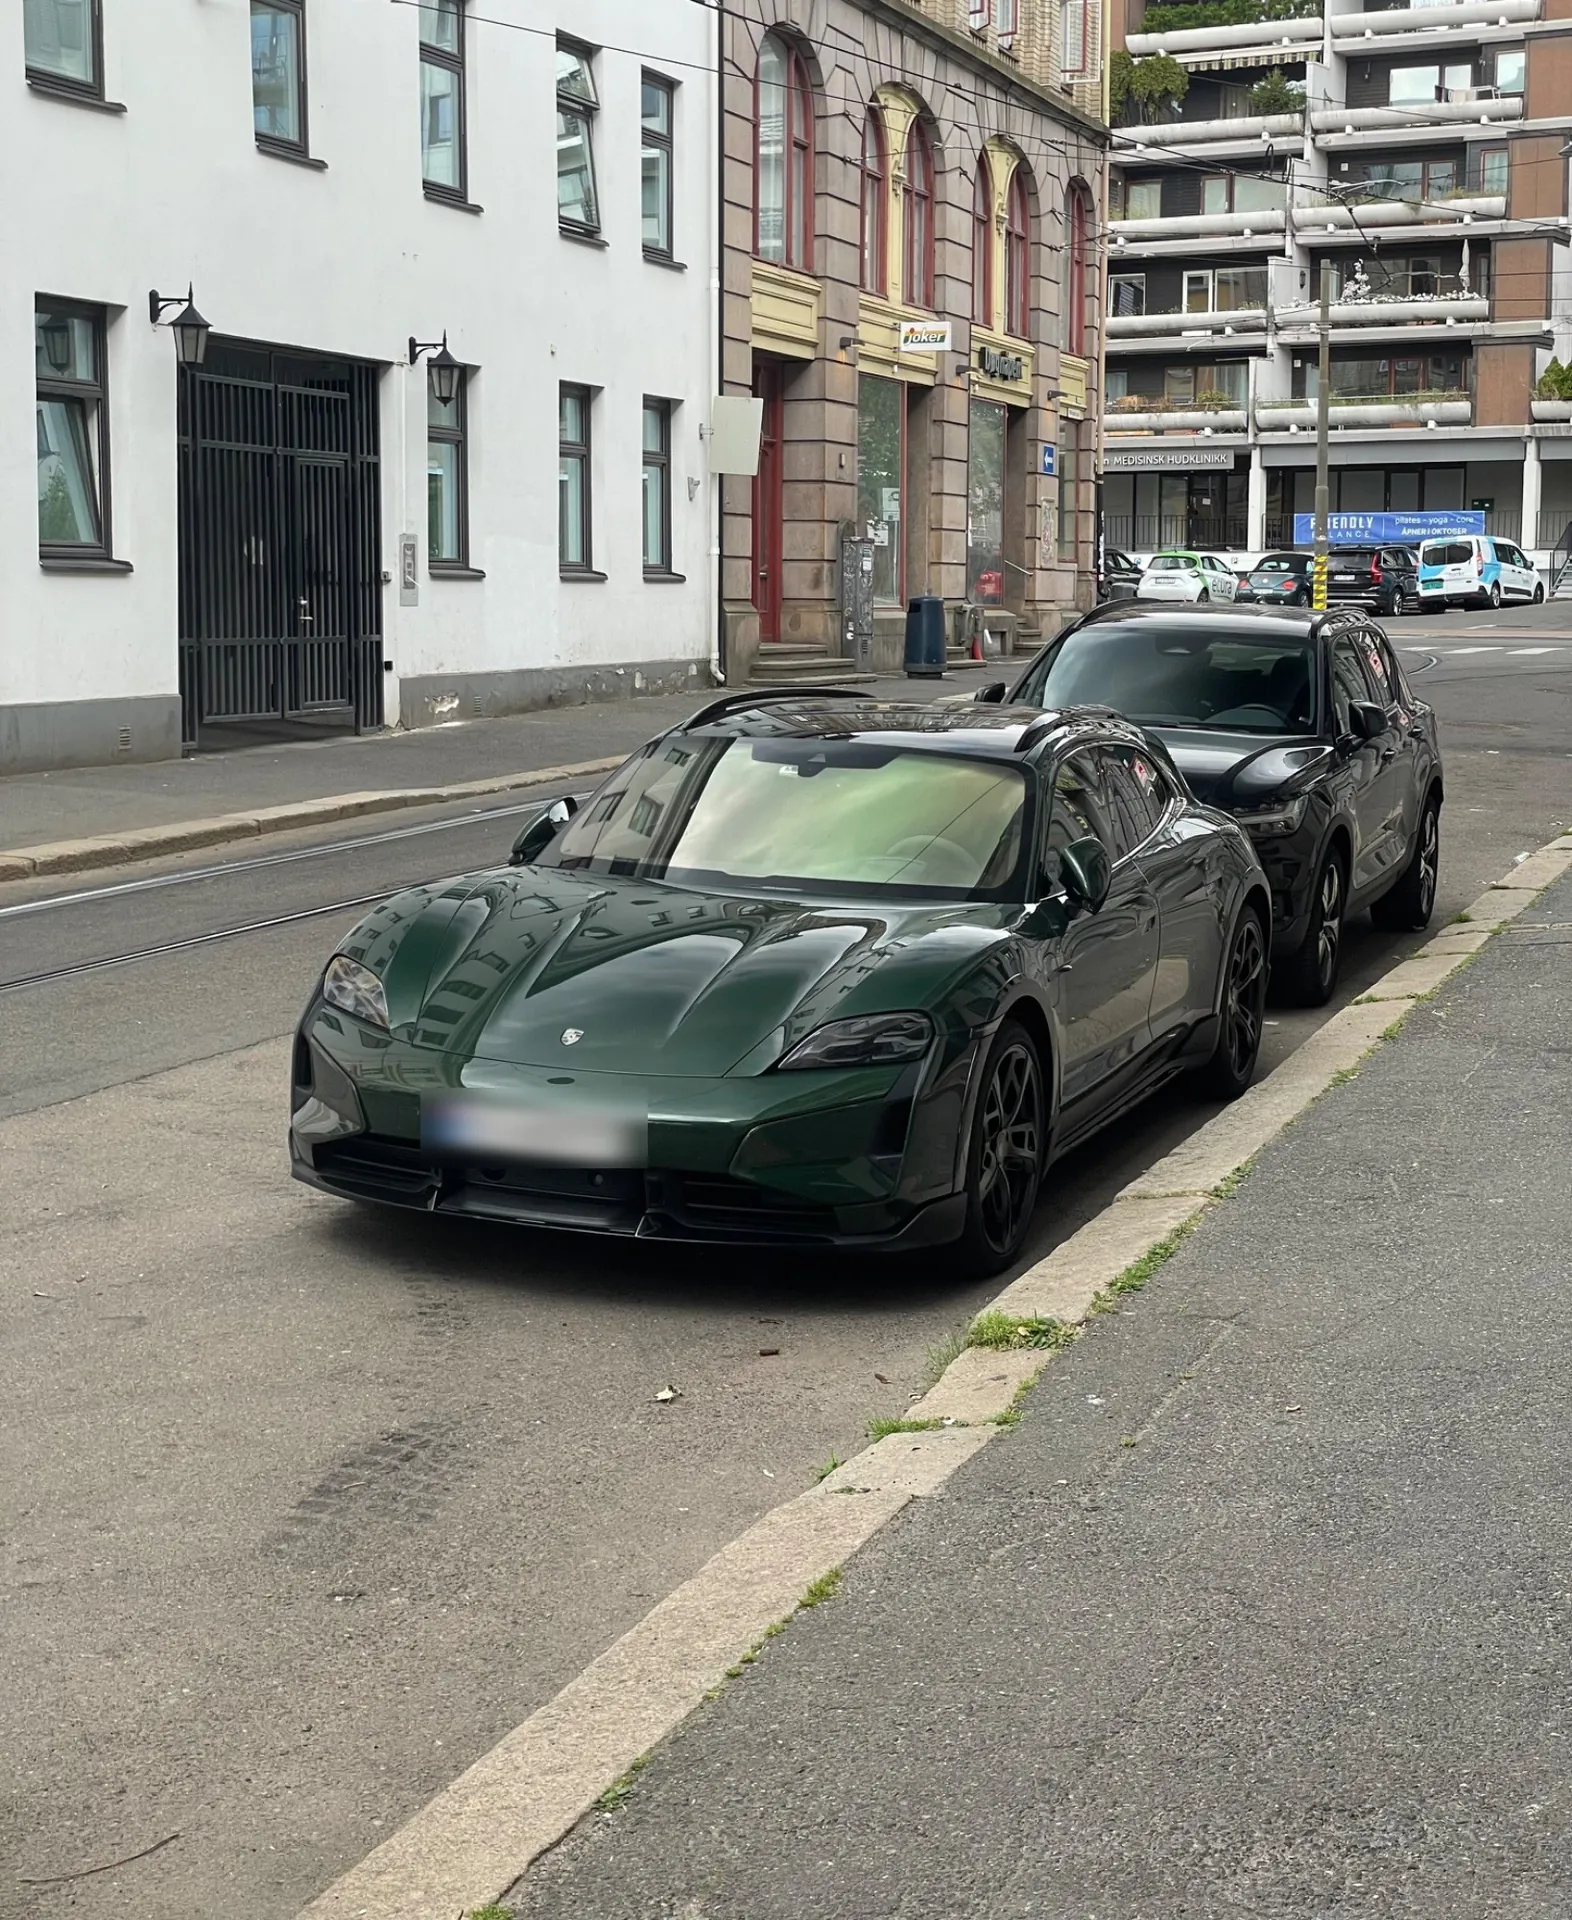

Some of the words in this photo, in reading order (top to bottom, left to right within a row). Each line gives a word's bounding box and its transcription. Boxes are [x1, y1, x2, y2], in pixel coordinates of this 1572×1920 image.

[904, 328, 944, 345] joker
[1114, 455, 1165, 466] MEDISINSK
[1167, 453, 1227, 465] HUDKLINIKK
[1310, 516, 1373, 529] FIENDLY
[1395, 516, 1421, 525] pilates
[1429, 517, 1448, 525] yoga
[1312, 530, 1370, 538] BLANCE
[1401, 527, 1426, 535] ÅPNER
